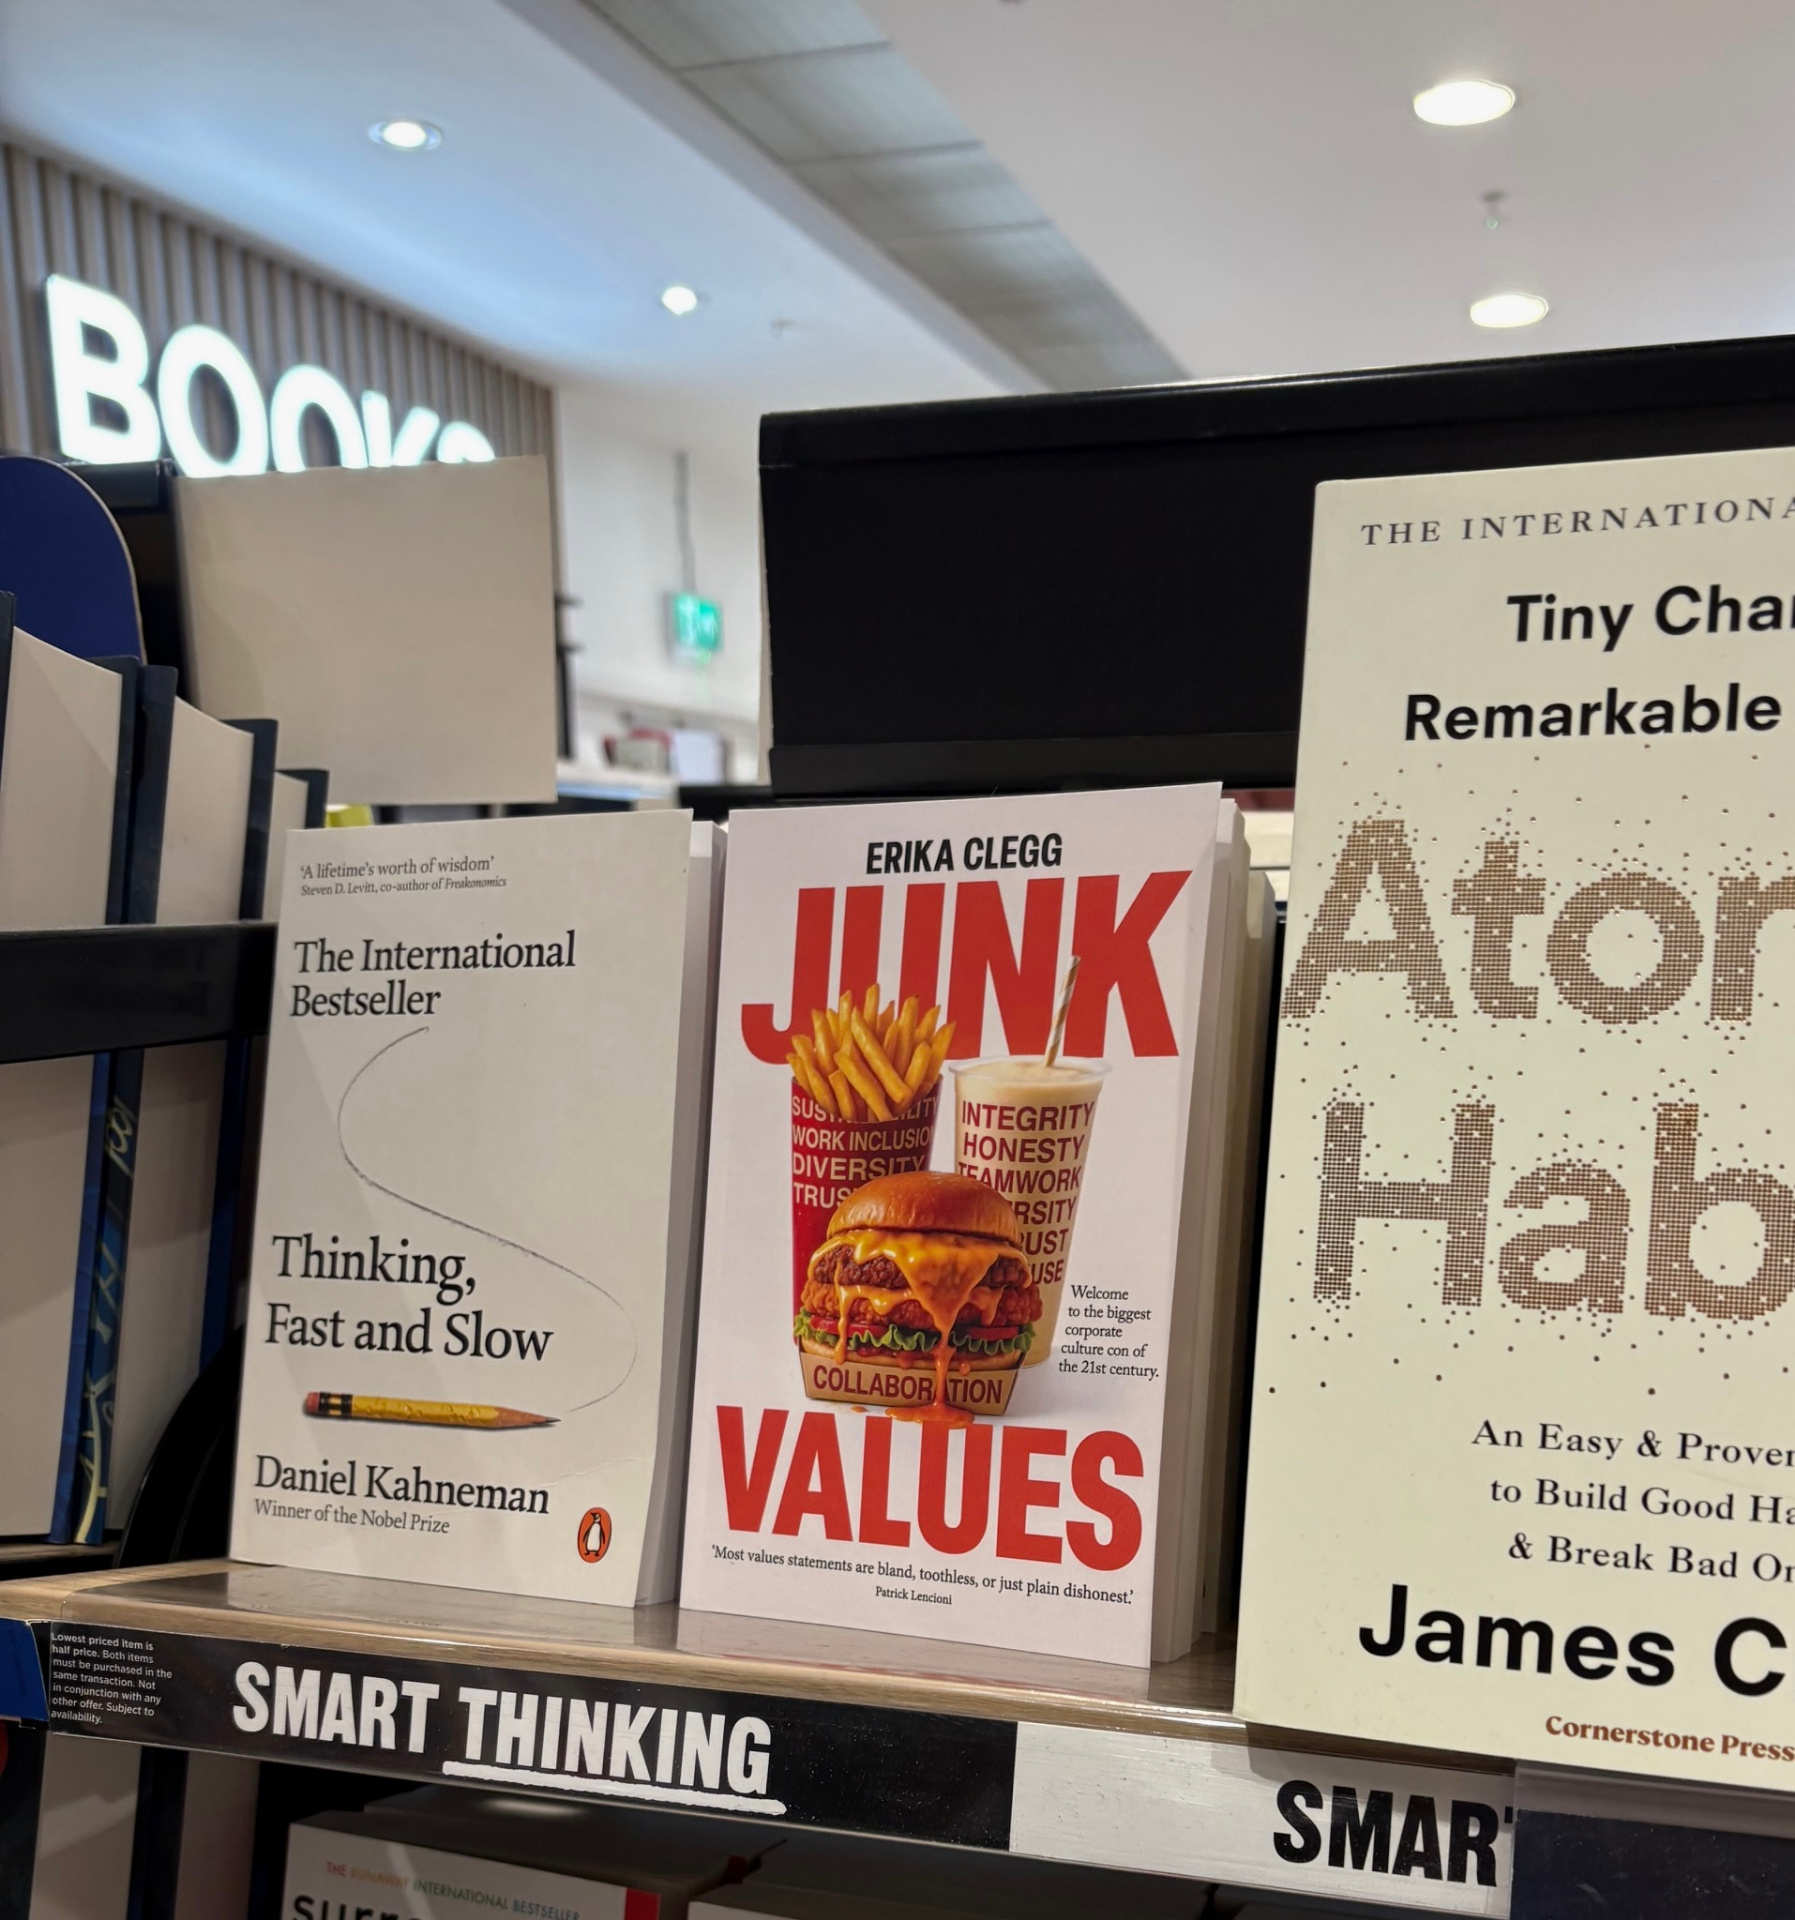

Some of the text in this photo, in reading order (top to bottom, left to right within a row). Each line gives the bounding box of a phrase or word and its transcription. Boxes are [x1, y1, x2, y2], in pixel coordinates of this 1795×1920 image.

[1361, 520, 1442, 546] THE
[1507, 584, 1795, 653] Tiny Cha
[1405, 682, 1782, 741] Remarkable
[317, 862, 374, 878] lifetime’s
[378, 859, 417, 876] worth
[420, 857, 436, 874] of
[439, 855, 494, 873] wisdom’
[866, 833, 1063, 875] ERIKA CLEGG
[301, 876, 508, 896] Steven D. Levitt, co-author of Freakonomics
[294, 929, 576, 973] The International
[740, 870, 1193, 1065] JUNK
[290, 979, 441, 1017] Bestseller
[962, 1100, 1095, 1131] INTEGRITY
[792, 1124, 845, 1151] WORK
[963, 1132, 1085, 1163] HONESTY
[793, 1152, 925, 1181] DIVERSITY
[1009, 1196, 1077, 1225] RSITY
[1312, 1101, 1795, 1321] Hab
[272, 1232, 476, 1306] Thinking,
[1071, 1284, 1129, 1300] Welcome
[1068, 1304, 1152, 1324] to the biggest
[265, 1302, 554, 1361] Fast and Slow
[1065, 1326, 1122, 1340] corporate
[1061, 1341, 1148, 1358] culture con of
[1058, 1359, 1159, 1381] the 21st century.
[1471, 1419, 1523, 1447] An
[1538, 1423, 1624, 1460] Easy
[1637, 1430, 1663, 1458] &
[254, 1454, 550, 1514] Daniel Kahneman
[716, 1404, 1144, 1571] VALUES
[1490, 1480, 1521, 1503] to
[1535, 1478, 1627, 1512] Build
[1641, 1487, 1735, 1521] Good
[254, 1498, 450, 1534] Winner of the Nobel Prize
[1508, 1532, 1533, 1560] &
[1547, 1535, 1654, 1571] Break
[1668, 1546, 1738, 1578] Bad
[747, 1549, 785, 1565] values
[788, 1556, 852, 1572] statements
[855, 1563, 875, 1574] are
[877, 1561, 916, 1580] bland,
[920, 1567, 978, 1588] toothless,
[982, 1576, 996, 1588] or
[998, 1576, 1023, 1593] just
[1026, 1578, 1060, 1596] plain
[875, 1586, 952, 1605] Patrick Lencioni
[51, 1632, 86, 1643] Lowest
[88, 1637, 119, 1647] priced
[145, 1641, 154, 1651] is
[52, 1644, 154, 1664] half price. Both items
[1359, 1583, 1788, 1697] James C
[53, 1659, 173, 1678] must be purchased in the
[53, 1671, 156, 1690] same transaction. Not
[52, 1696, 154, 1717] other offer. Subject to
[53, 1683, 161, 1705] in conjunction with any
[51, 1709, 102, 1724] availability.
[232, 1660, 772, 1795] SMART THINKING
[1545, 1715, 1795, 1762] Cornerstone Press
[1273, 1780, 1514, 1887] SMAR
[326, 1861, 347, 1878] THE
[413, 1879, 509, 1910] INTERNATIONAL
[512, 1900, 581, 1920] BESTSELLER
